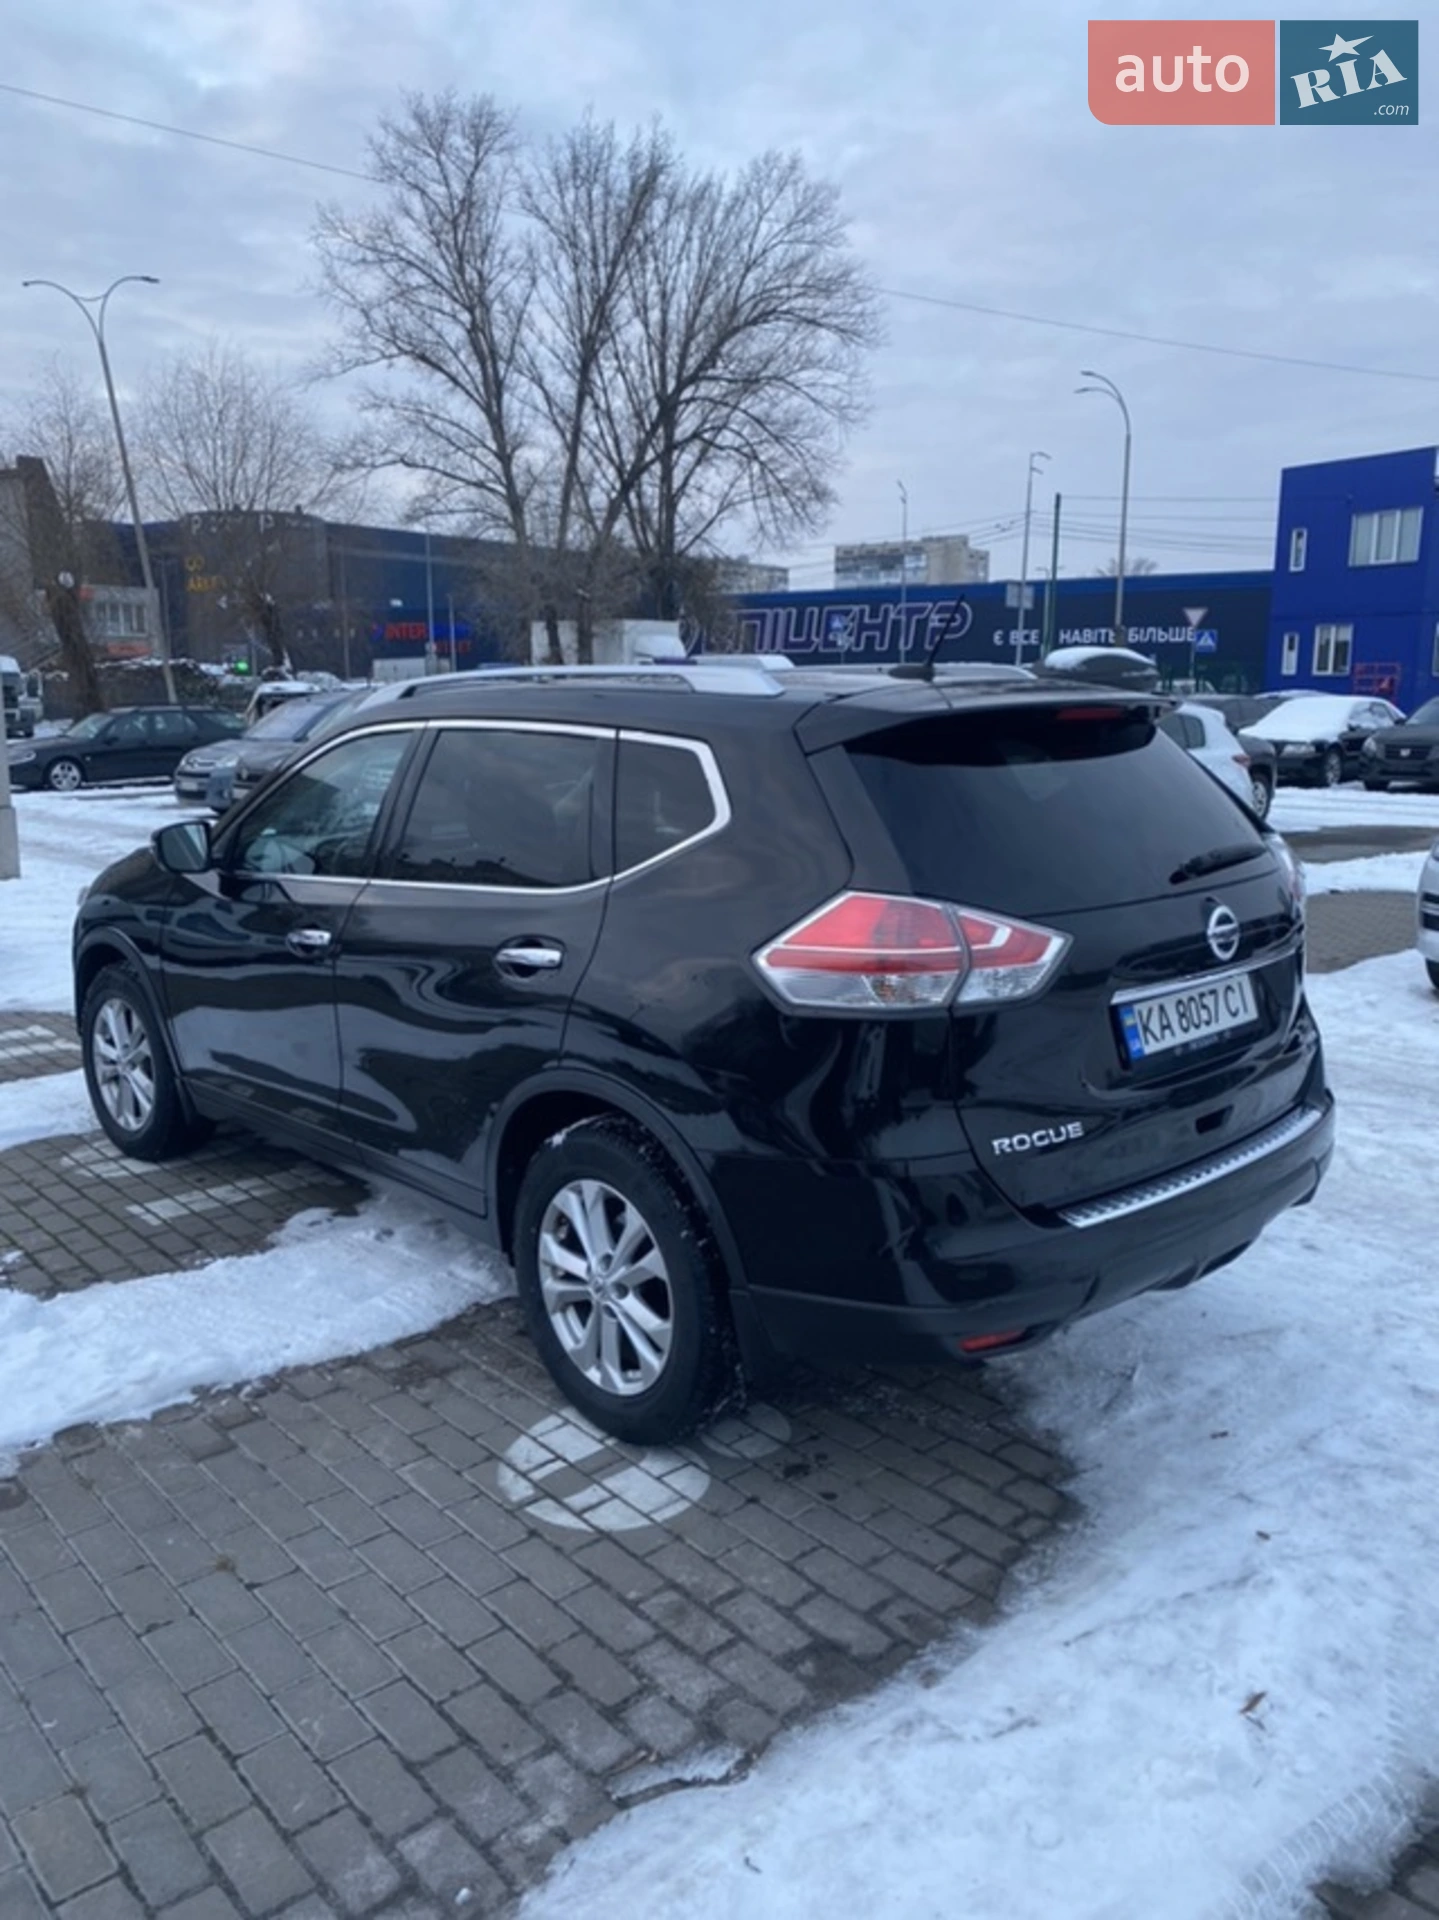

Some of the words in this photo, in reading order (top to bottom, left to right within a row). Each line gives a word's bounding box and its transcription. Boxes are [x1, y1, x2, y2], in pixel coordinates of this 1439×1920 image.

[1009, 629, 1040, 645] ВСЕ
[1127, 626, 1195, 643] БІЛЬШЕ
[1137, 1003, 1175, 1045] KA
[1175, 988, 1220, 1034] 8057
[992, 1121, 1084, 1156] ROGUE
